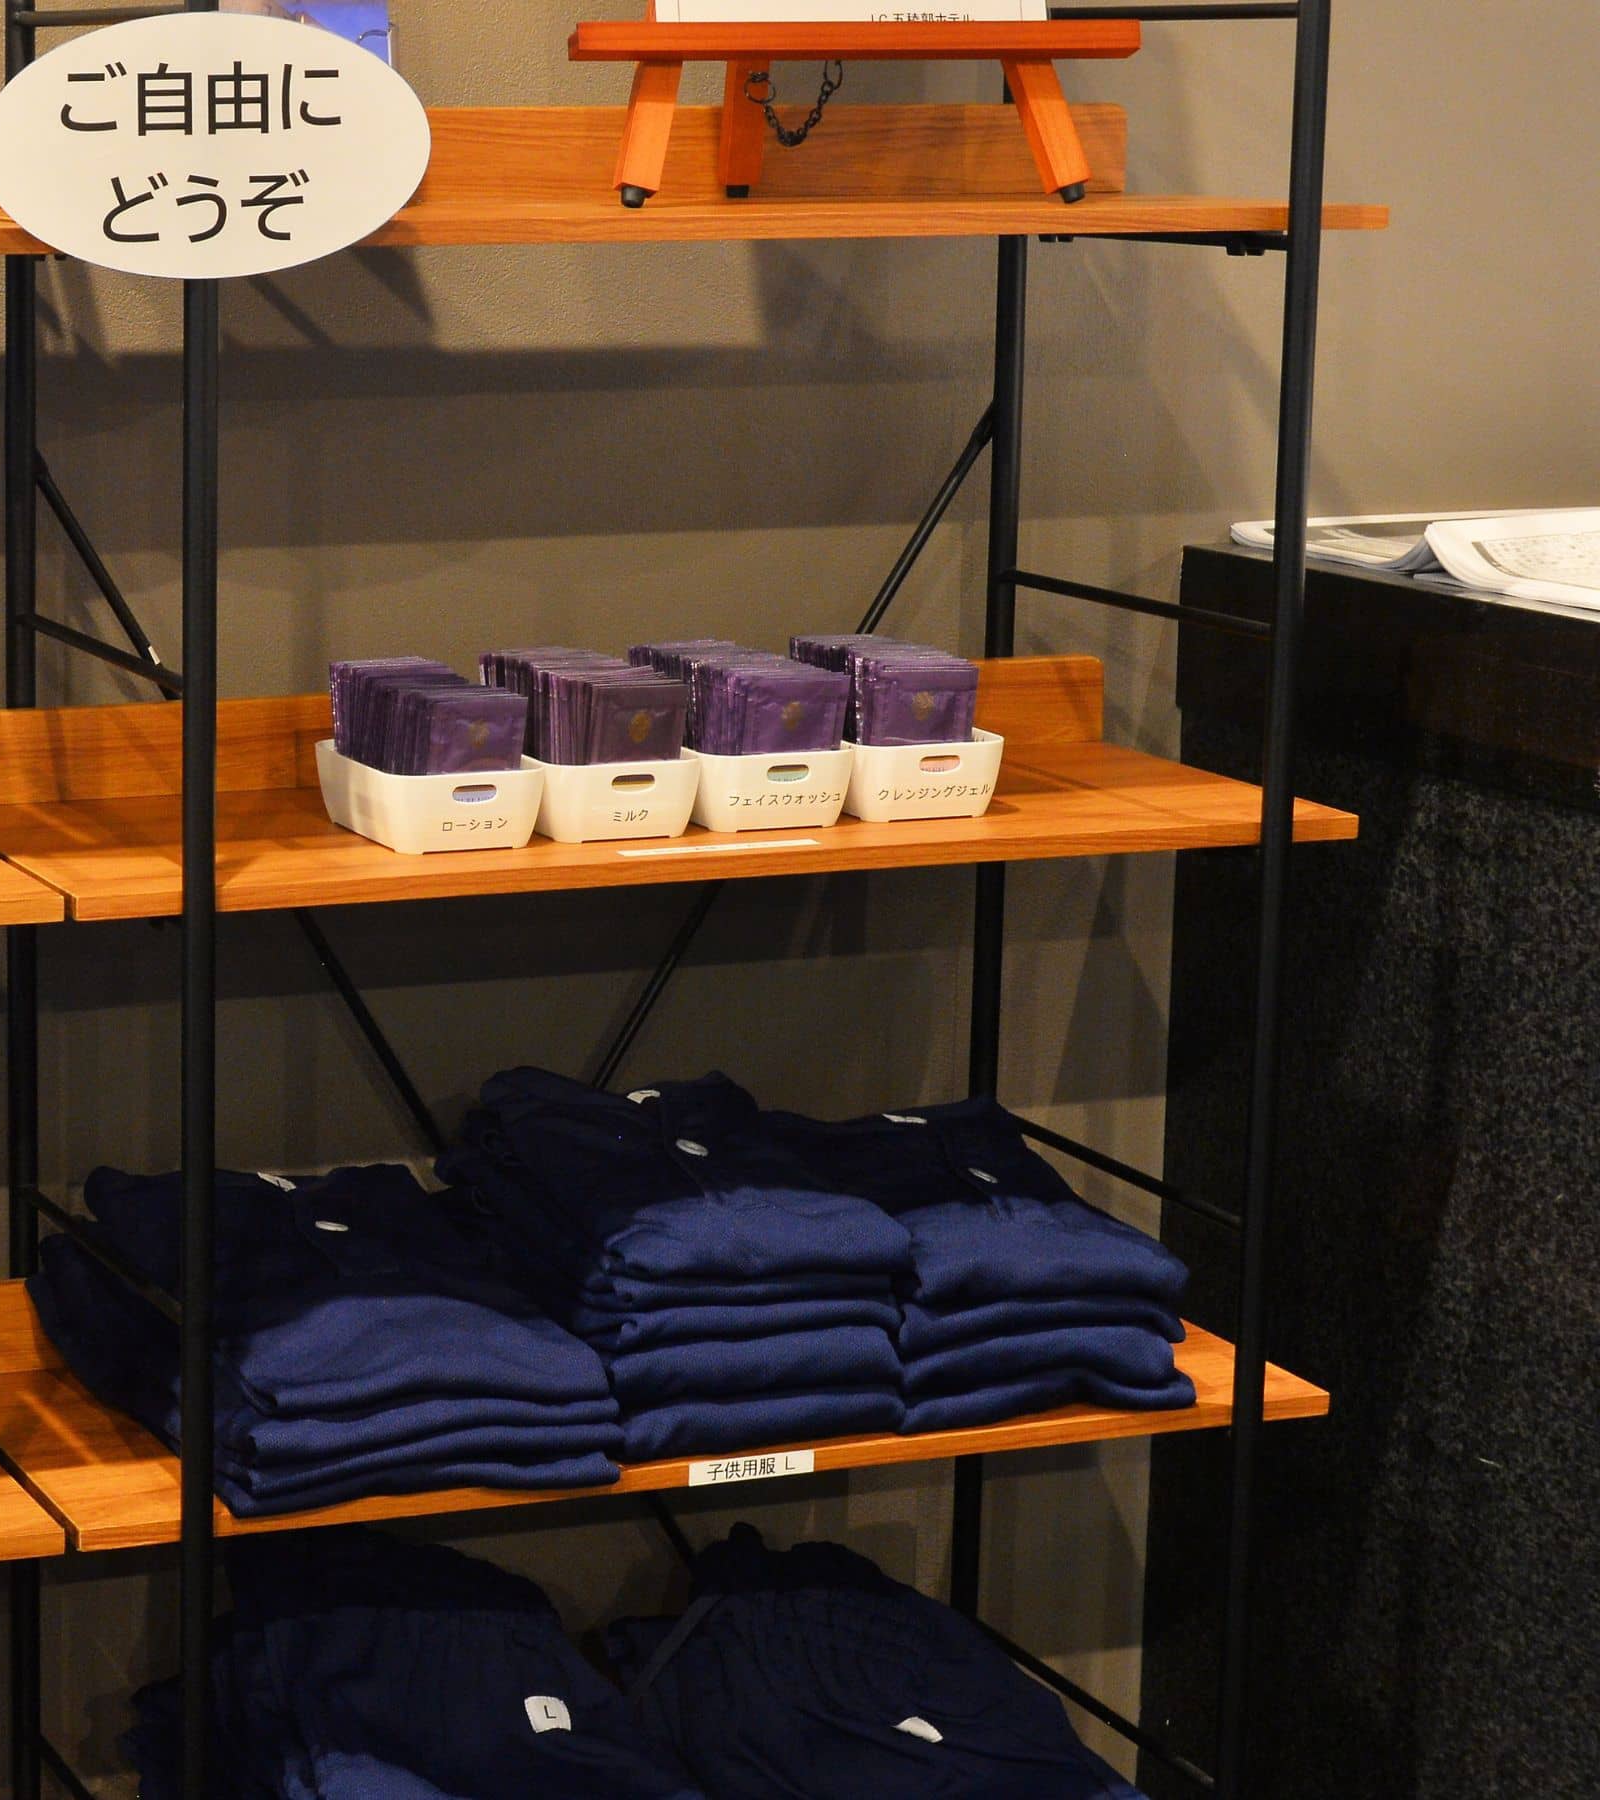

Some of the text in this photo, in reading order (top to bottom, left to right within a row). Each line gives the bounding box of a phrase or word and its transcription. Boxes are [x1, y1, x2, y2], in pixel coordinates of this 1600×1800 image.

[60, 61, 342, 136] ご自由に
[103, 169, 310, 243] どうぞ
[728, 791, 841, 807] フェイスウォッシュ
[877, 783, 991, 800] クレンジングジェル
[612, 808, 649, 822] ミルク
[442, 817, 508, 832] ローション
[706, 1455, 796, 1481] 子供用服 L
[544, 1705, 557, 1718] L
